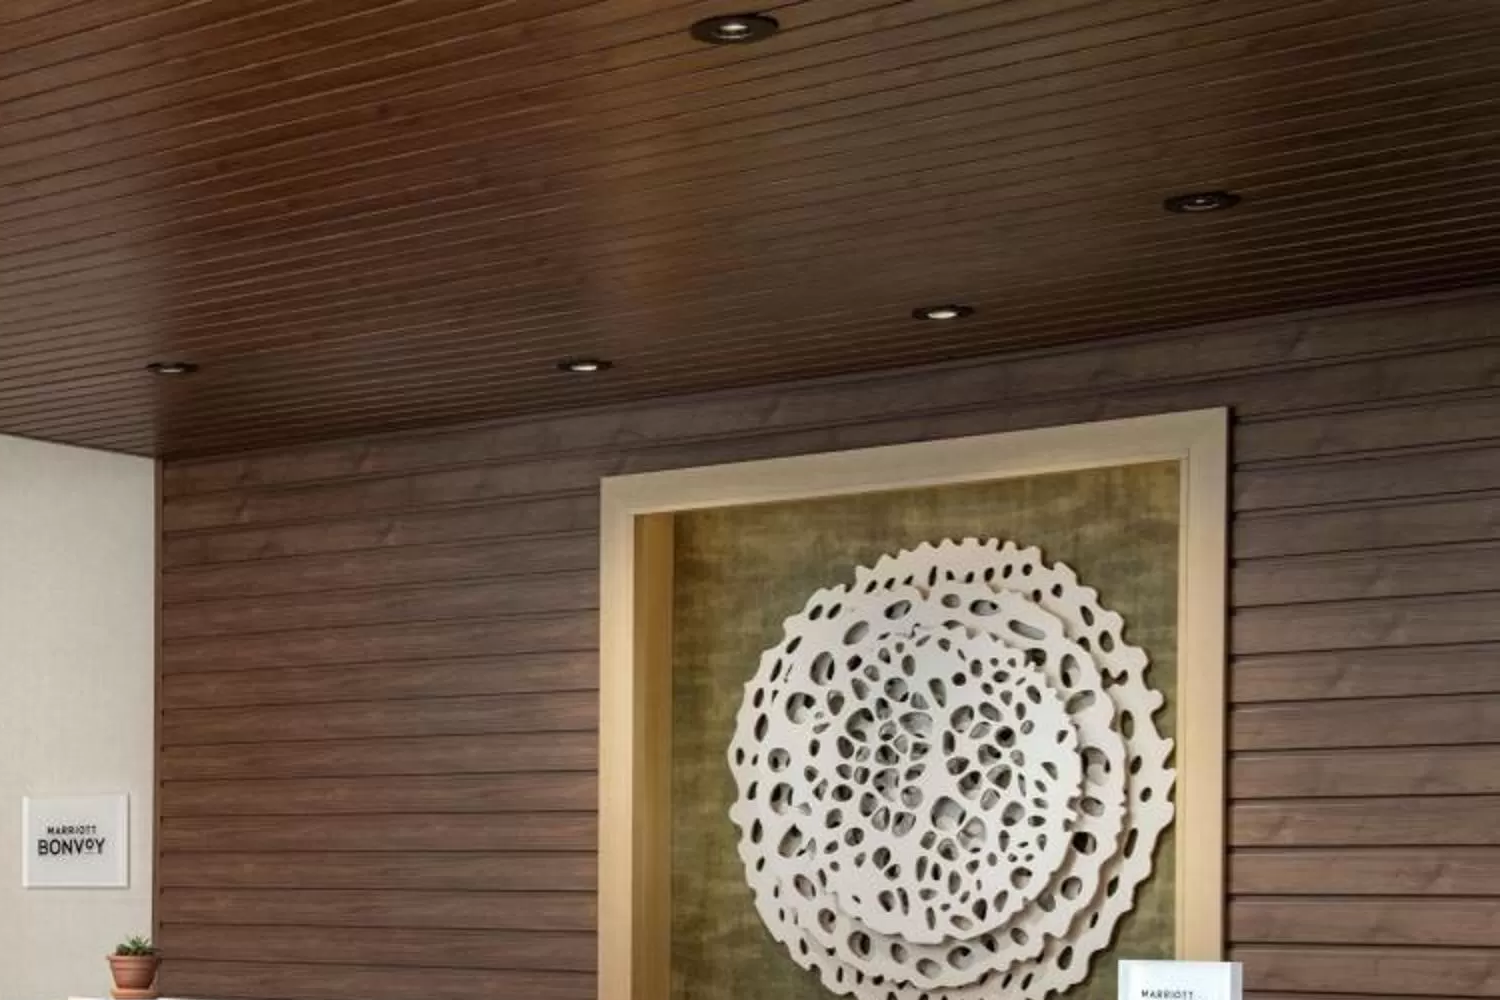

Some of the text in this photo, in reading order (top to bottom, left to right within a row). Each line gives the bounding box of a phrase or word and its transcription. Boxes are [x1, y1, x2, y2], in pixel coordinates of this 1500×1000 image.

[47, 825, 97, 835] MARRIOTT
[37, 838, 106, 856] BONVOY
[1141, 989, 1194, 1000] MARRIOTT
